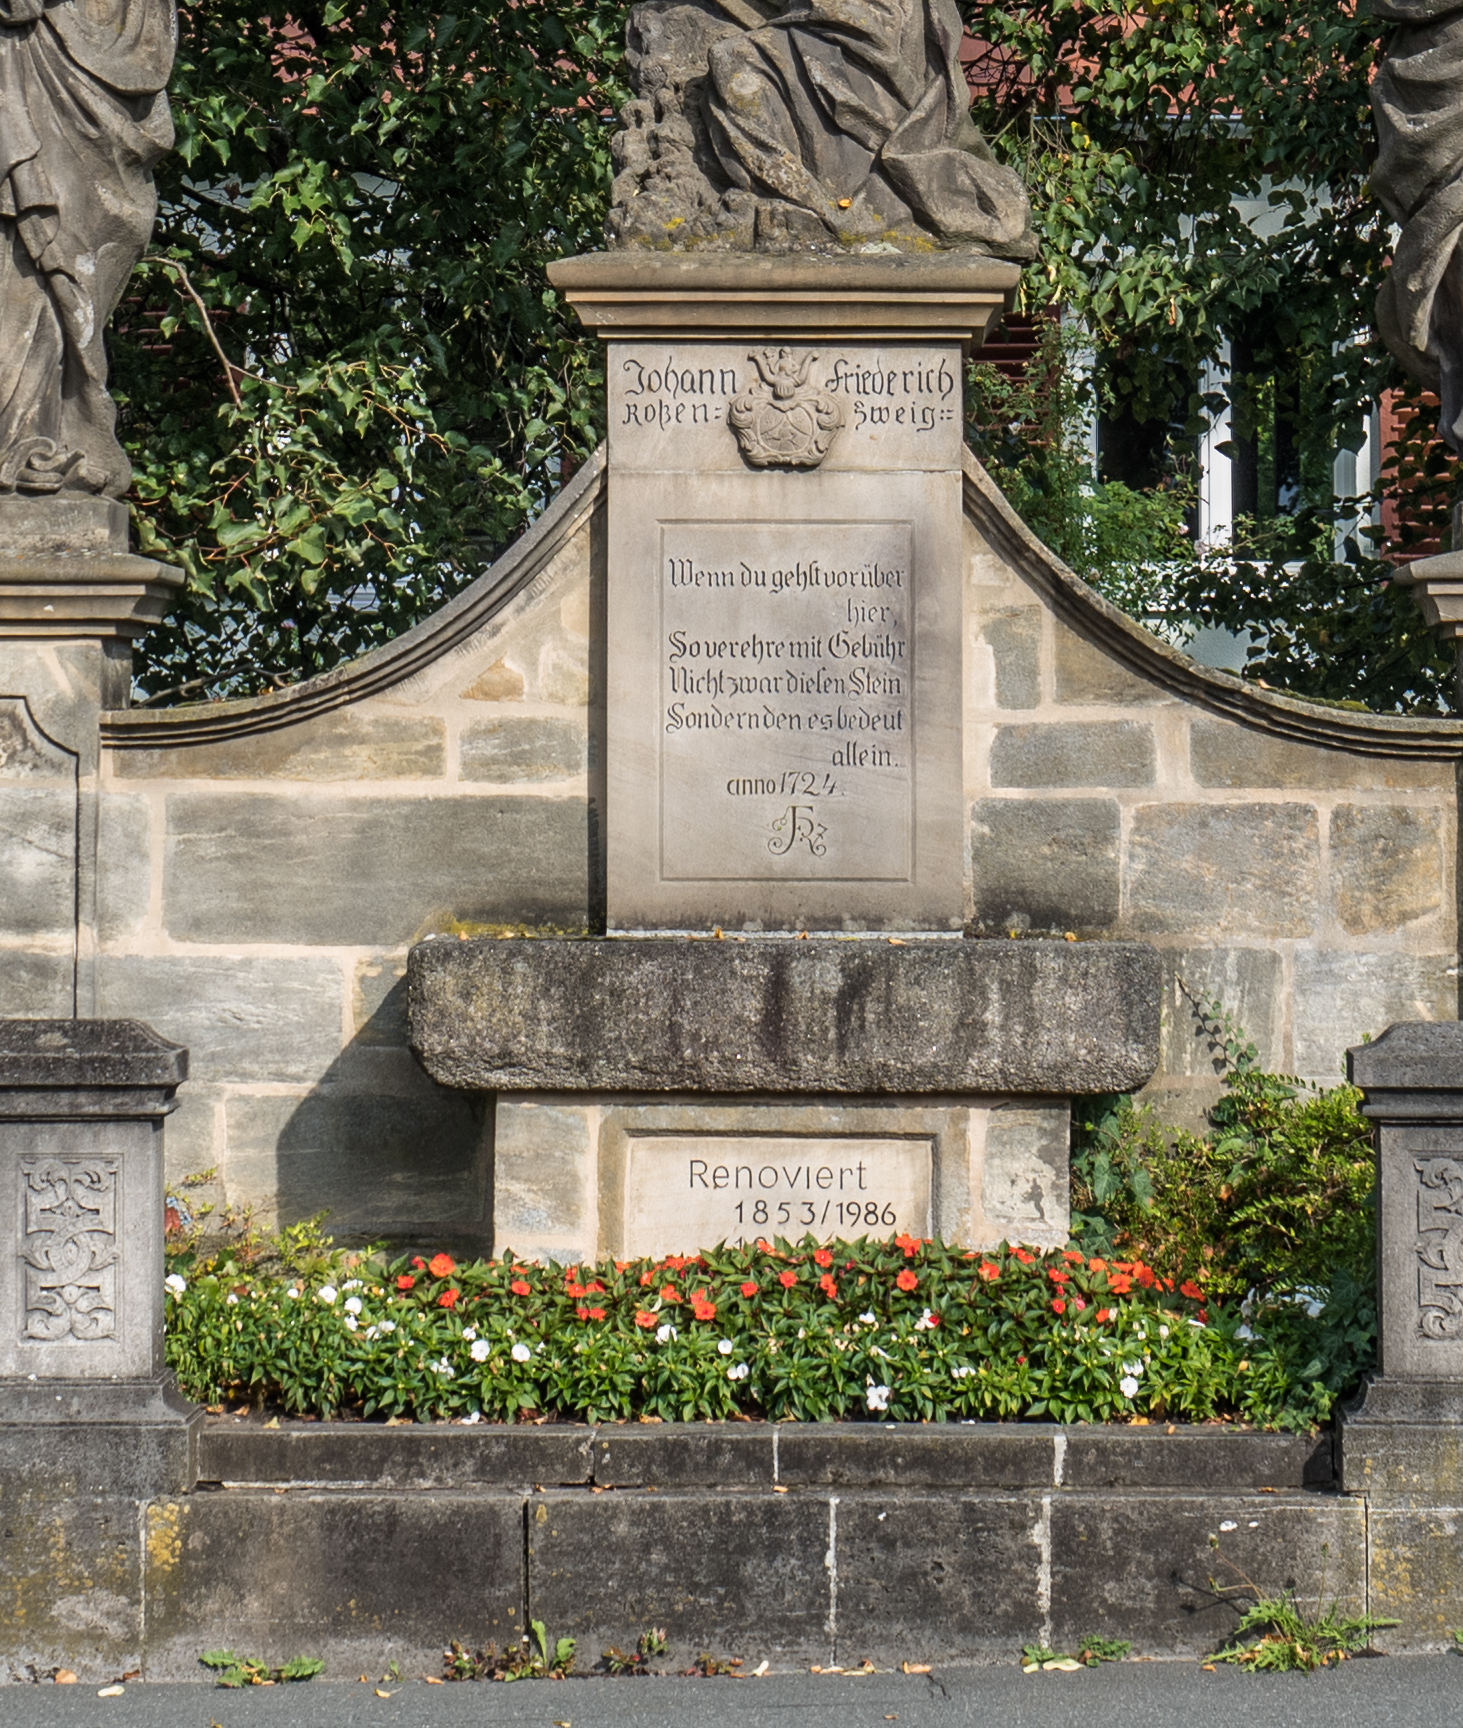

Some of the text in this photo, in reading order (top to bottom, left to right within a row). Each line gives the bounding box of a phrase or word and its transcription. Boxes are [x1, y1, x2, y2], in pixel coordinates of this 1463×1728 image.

[623, 356, 954, 400] Johann Friederich
[669, 558, 734, 588] Wenn
[740, 561, 766, 588] du
[824, 562, 905, 588] vorüber
[846, 598, 898, 627] hier,
[668, 630, 906, 664] So verehre mit Gebühr
[669, 666, 725, 700] Nicht
[727, 674, 783, 699] zwar
[847, 666, 902, 701] Stein
[665, 702, 904, 734] Sondern den es bedeut
[832, 741, 899, 767] allein.
[726, 778, 776, 796] anno
[689, 1159, 867, 1191] Renoviert
